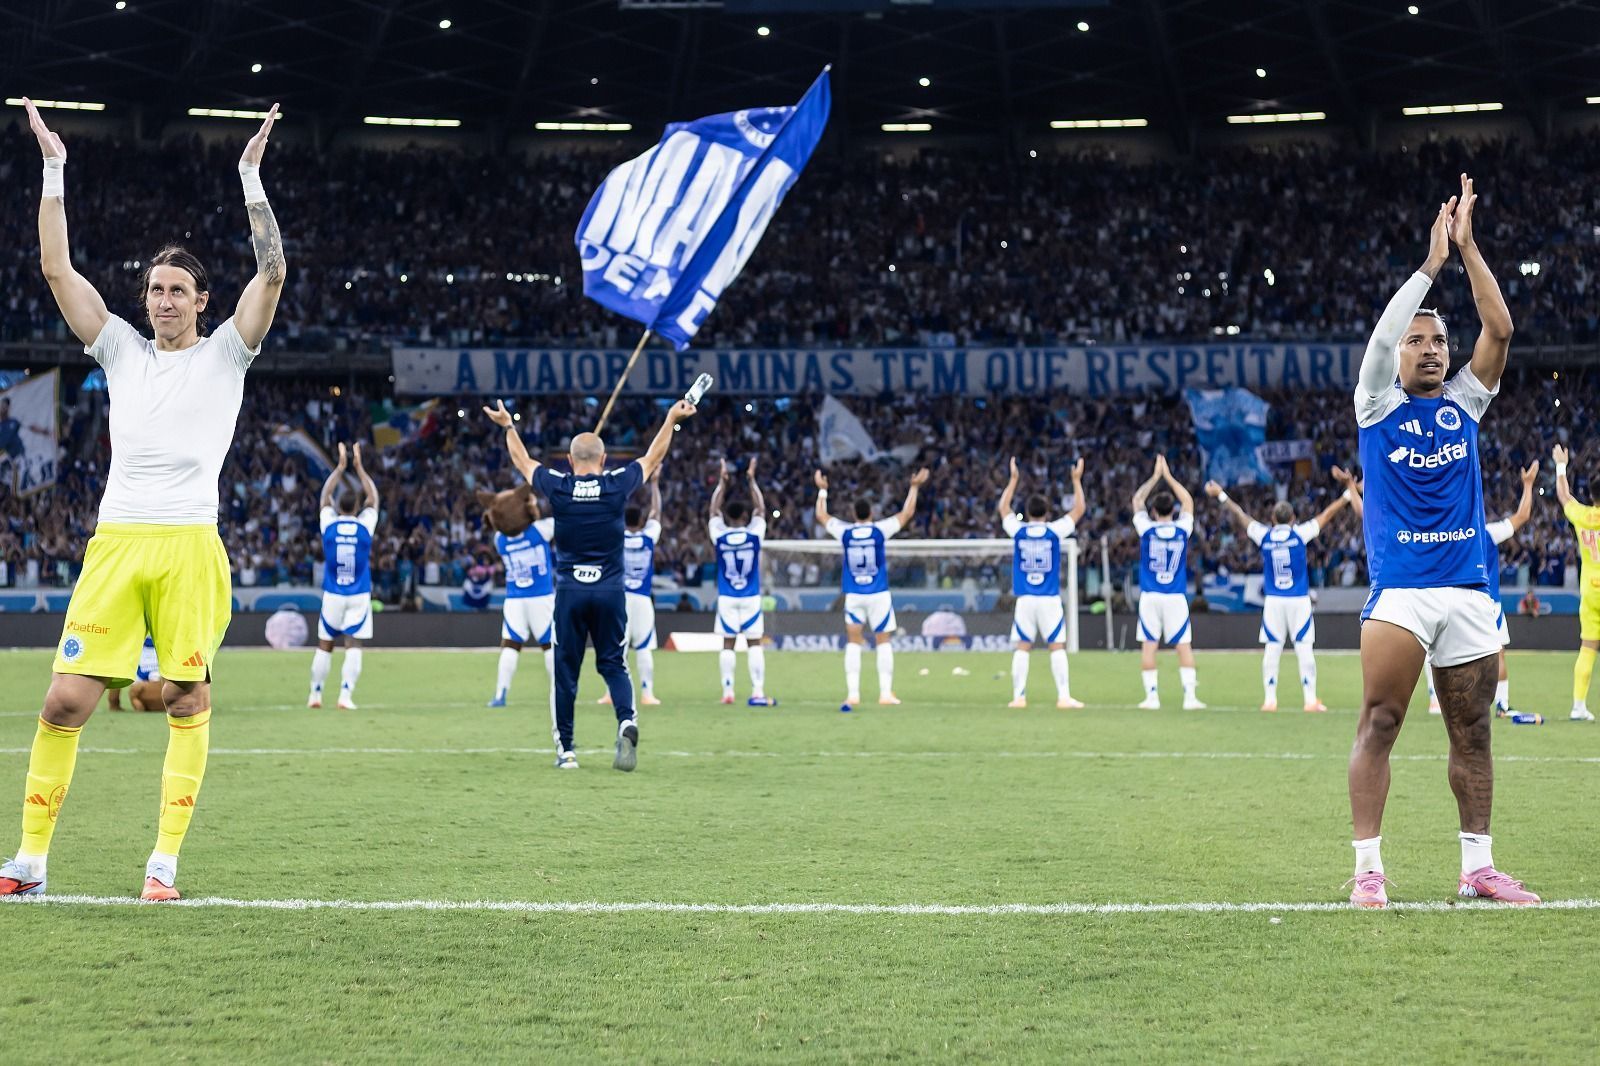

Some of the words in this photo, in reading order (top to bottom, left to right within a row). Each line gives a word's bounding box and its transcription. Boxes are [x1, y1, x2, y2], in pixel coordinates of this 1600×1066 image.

[454, 352, 477, 391] A
[492, 352, 626, 391] MAIOR
[647, 352, 700, 390] DE
[873, 350, 967, 394] TEM
[985, 350, 1069, 395] QUE
[1084, 345, 1351, 395] RESPEITAR!
[1408, 438, 1468, 468] betfair
[1413, 527, 1476, 543] PERDIGÃO
[73, 621, 111, 634] betfair
